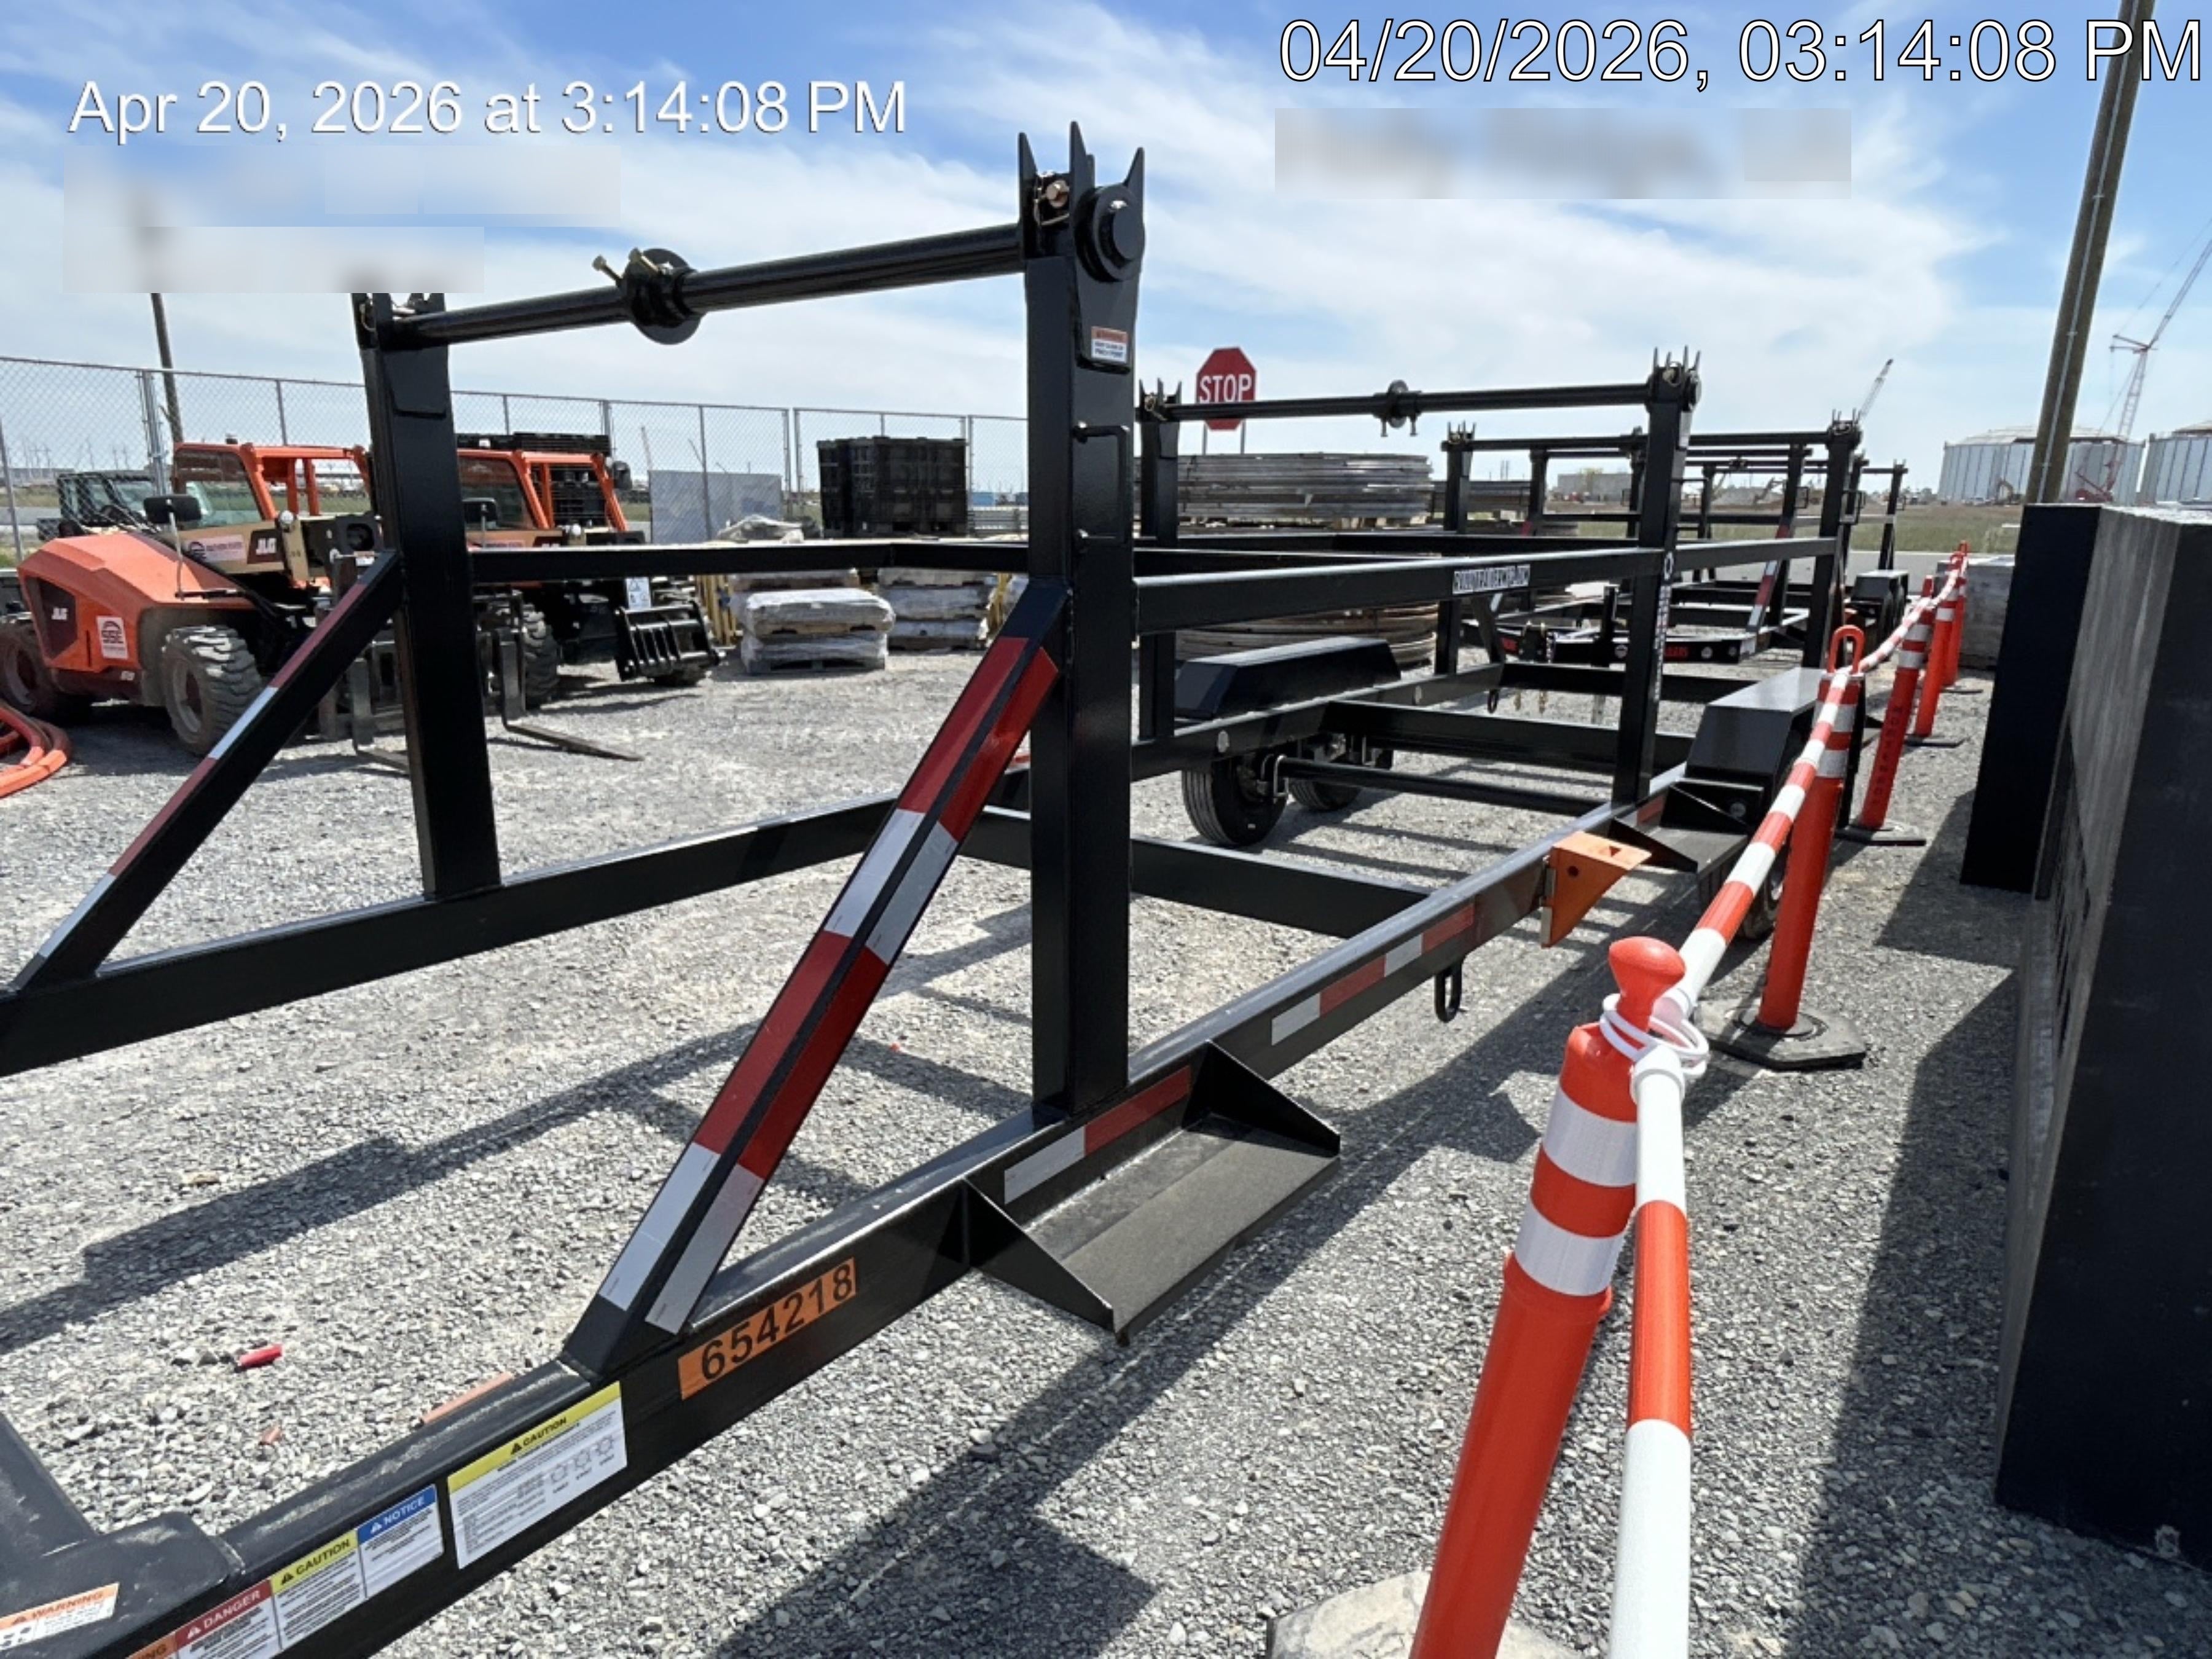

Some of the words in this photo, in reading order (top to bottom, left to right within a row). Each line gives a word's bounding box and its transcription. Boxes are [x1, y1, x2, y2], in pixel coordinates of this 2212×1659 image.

[1199, 374, 1252, 403] STOP
[256, 538, 276, 555] JLG
[701, 1263, 853, 1379] 654218
[523, 1417, 567, 1446] CAUTION
[383, 1496, 425, 1526] NOTICE
[296, 1538, 351, 1575] CAUTION
[33, 1591, 103, 1620] WARNING
[203, 1590, 261, 1629] DANGER
